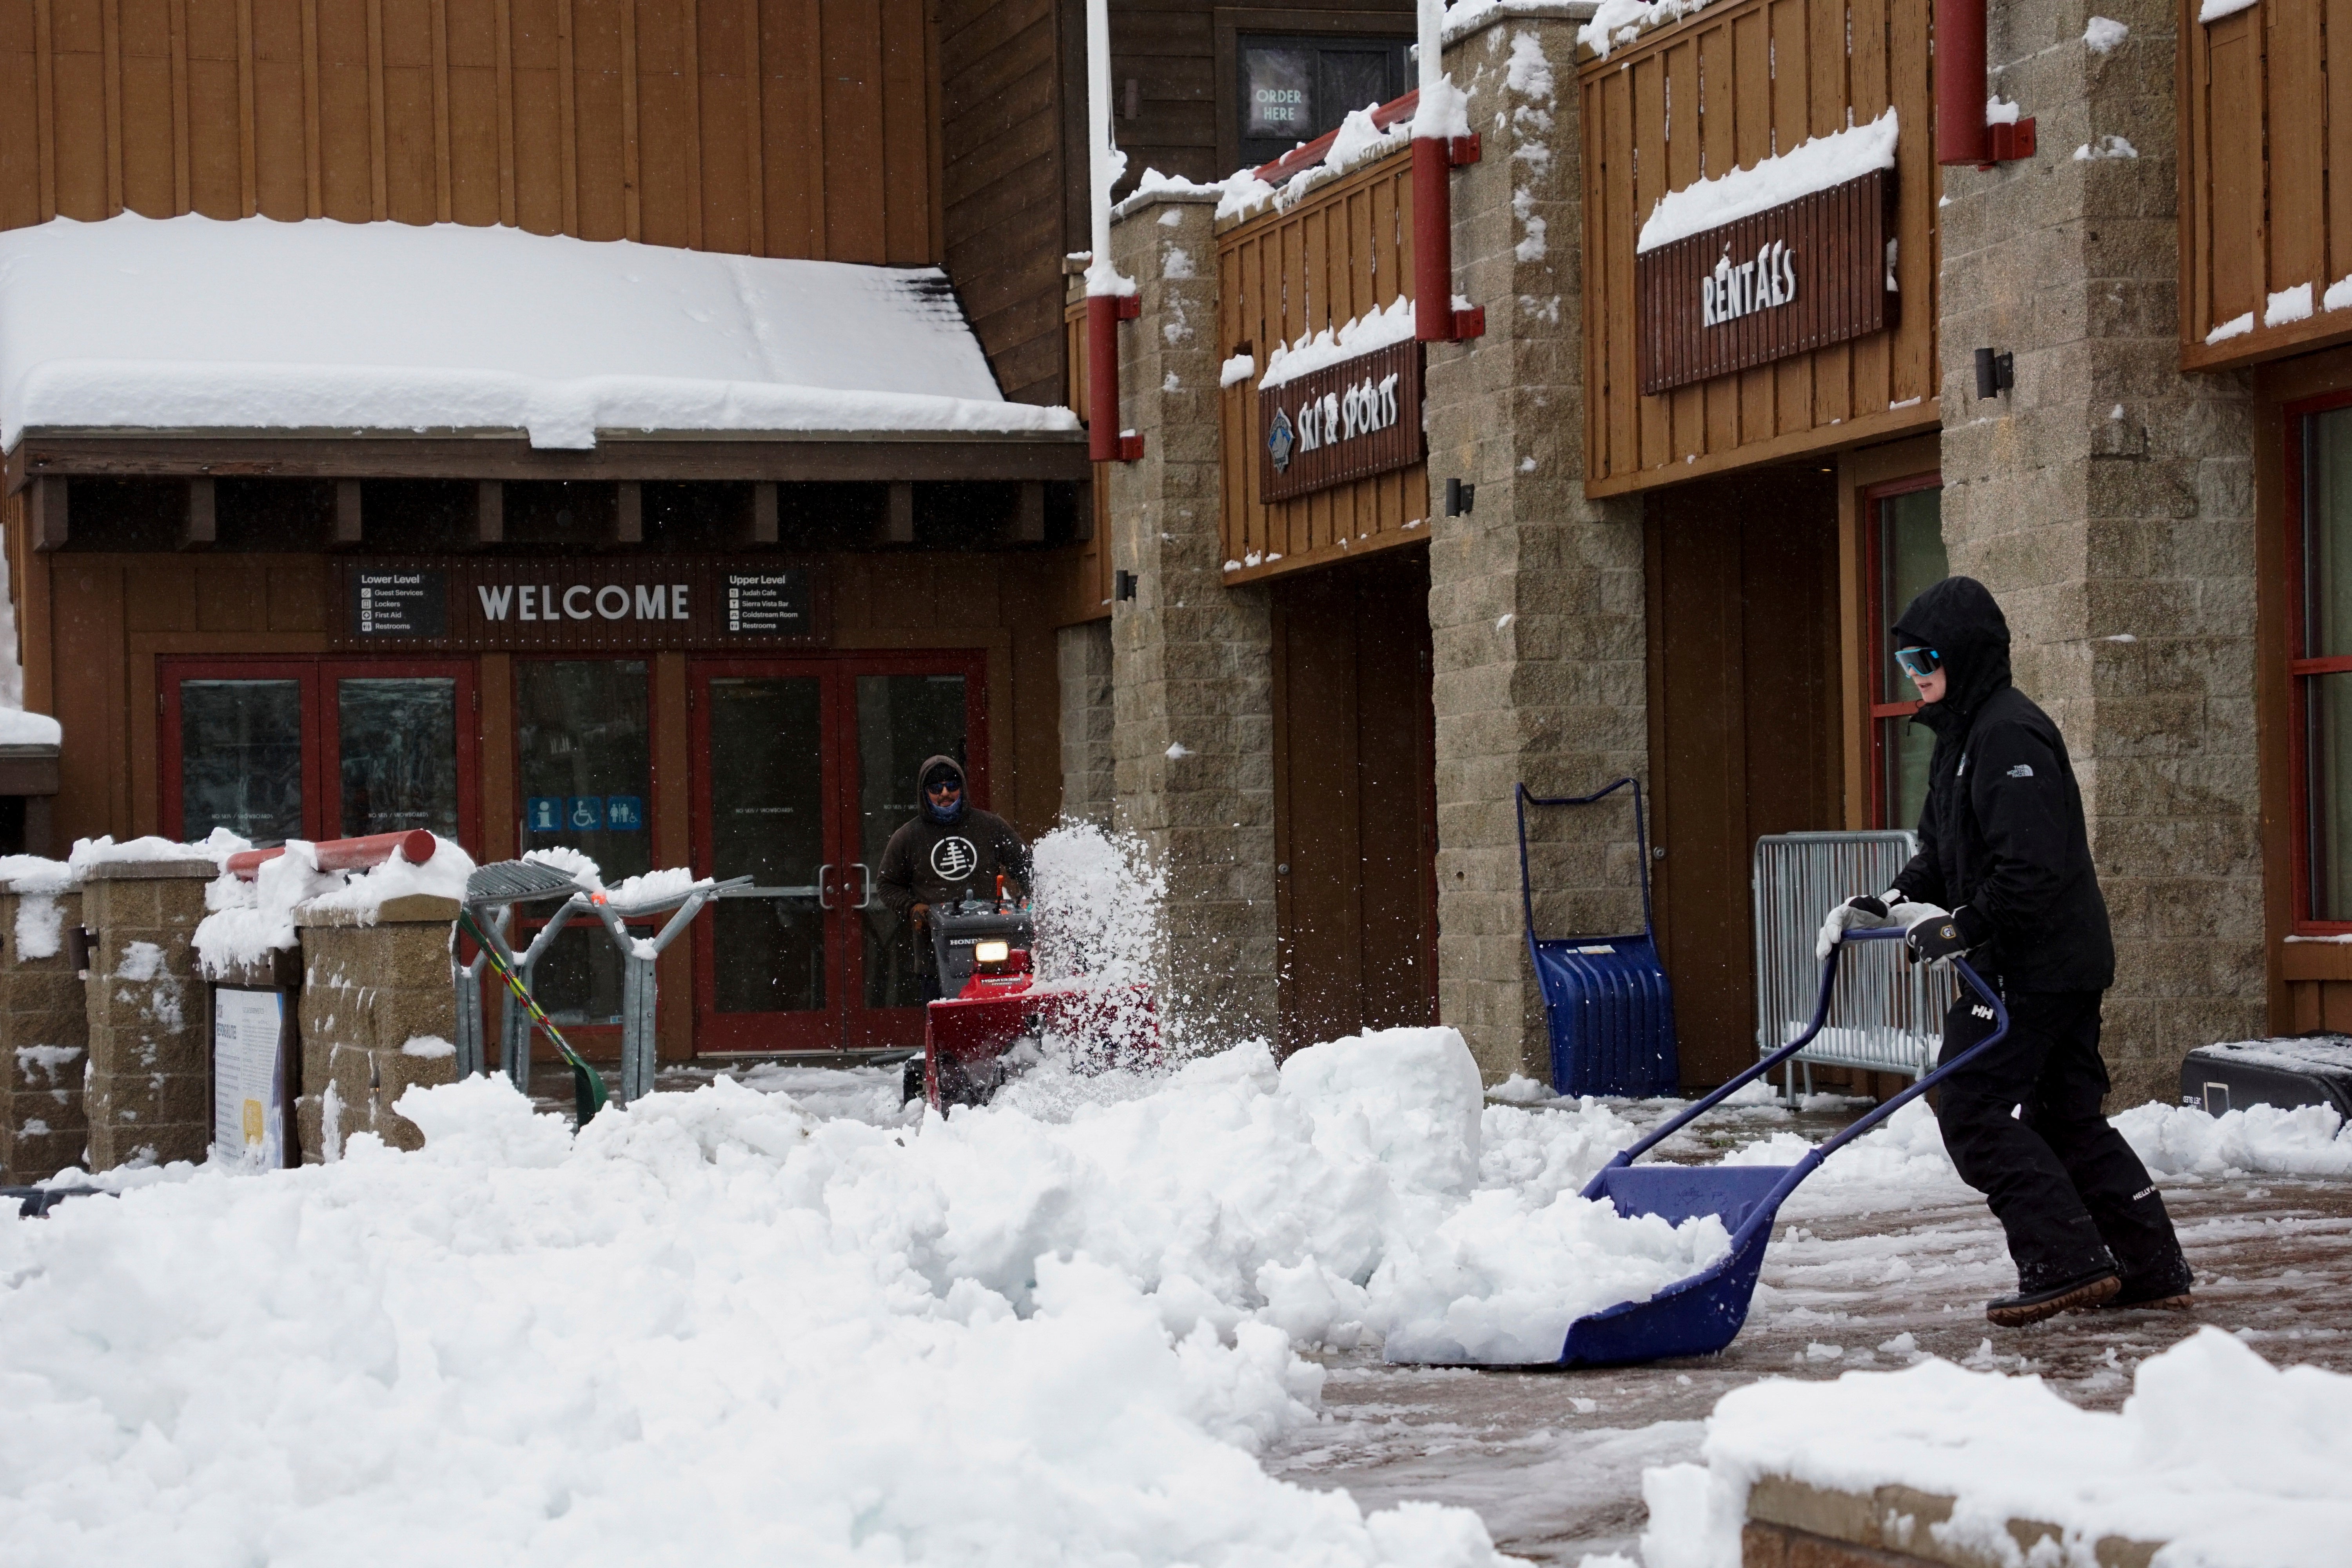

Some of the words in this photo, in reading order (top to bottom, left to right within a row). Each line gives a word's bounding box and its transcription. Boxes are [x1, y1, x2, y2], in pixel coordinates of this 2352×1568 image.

[1256, 89, 1301, 103] ORDER
[1264, 107, 1294, 120] HERE
[1703, 248, 1795, 327] RENTALS
[1298, 406, 1321, 452] SKI
[1342, 379, 1397, 440] SPORTS
[361, 575, 392, 583] Lower
[394, 574, 419, 583] Level
[730, 575, 759, 585] Upper
[761, 575, 785, 584] Level
[477, 585, 689, 620] WELCOME
[1971, 1004, 1994, 1020] HH
[2133, 1187, 2151, 1200] HELLY
